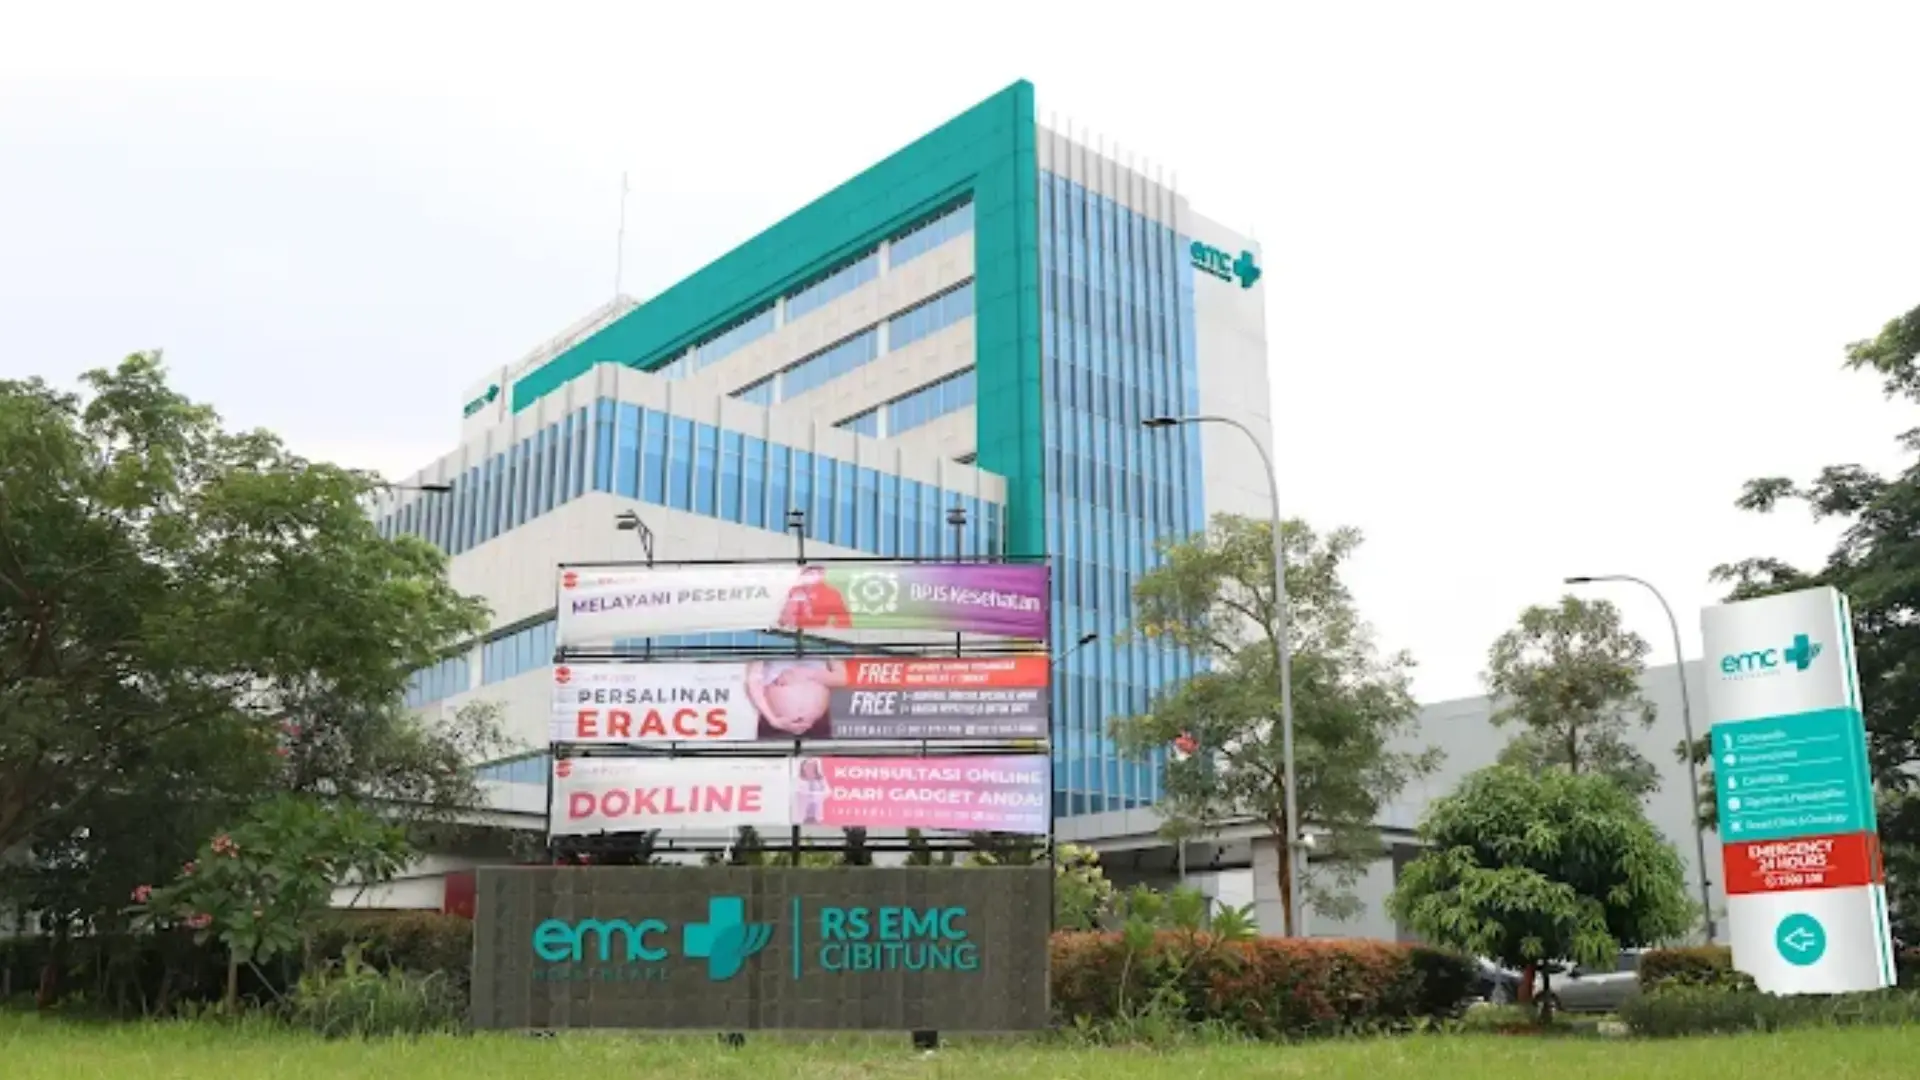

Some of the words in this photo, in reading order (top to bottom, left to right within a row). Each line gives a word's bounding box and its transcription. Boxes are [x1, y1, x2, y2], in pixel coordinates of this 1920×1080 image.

[572, 591, 671, 615] MELAYANI
[678, 585, 770, 604] PESERTA
[910, 582, 948, 601] BPJS
[951, 585, 1040, 613] Kesehatan
[856, 662, 904, 684] FREE
[1720, 648, 1778, 673] emc
[578, 687, 730, 705] PERSALINAN
[850, 690, 898, 716] FREE
[577, 708, 728, 738] ERACS
[834, 765, 961, 782] KONSULTASI
[966, 768, 1043, 784] ONLINE
[568, 785, 763, 820] DOKLINE
[833, 787, 883, 802] DARI
[888, 788, 975, 804] GADGET
[1748, 839, 1834, 859] EMERGENCY
[1776, 853, 1827, 870] HOURS
[821, 907, 870, 940] RS
[879, 907, 968, 940] EMC
[532, 917, 668, 962] emc
[820, 943, 979, 970] CIBITUNG
